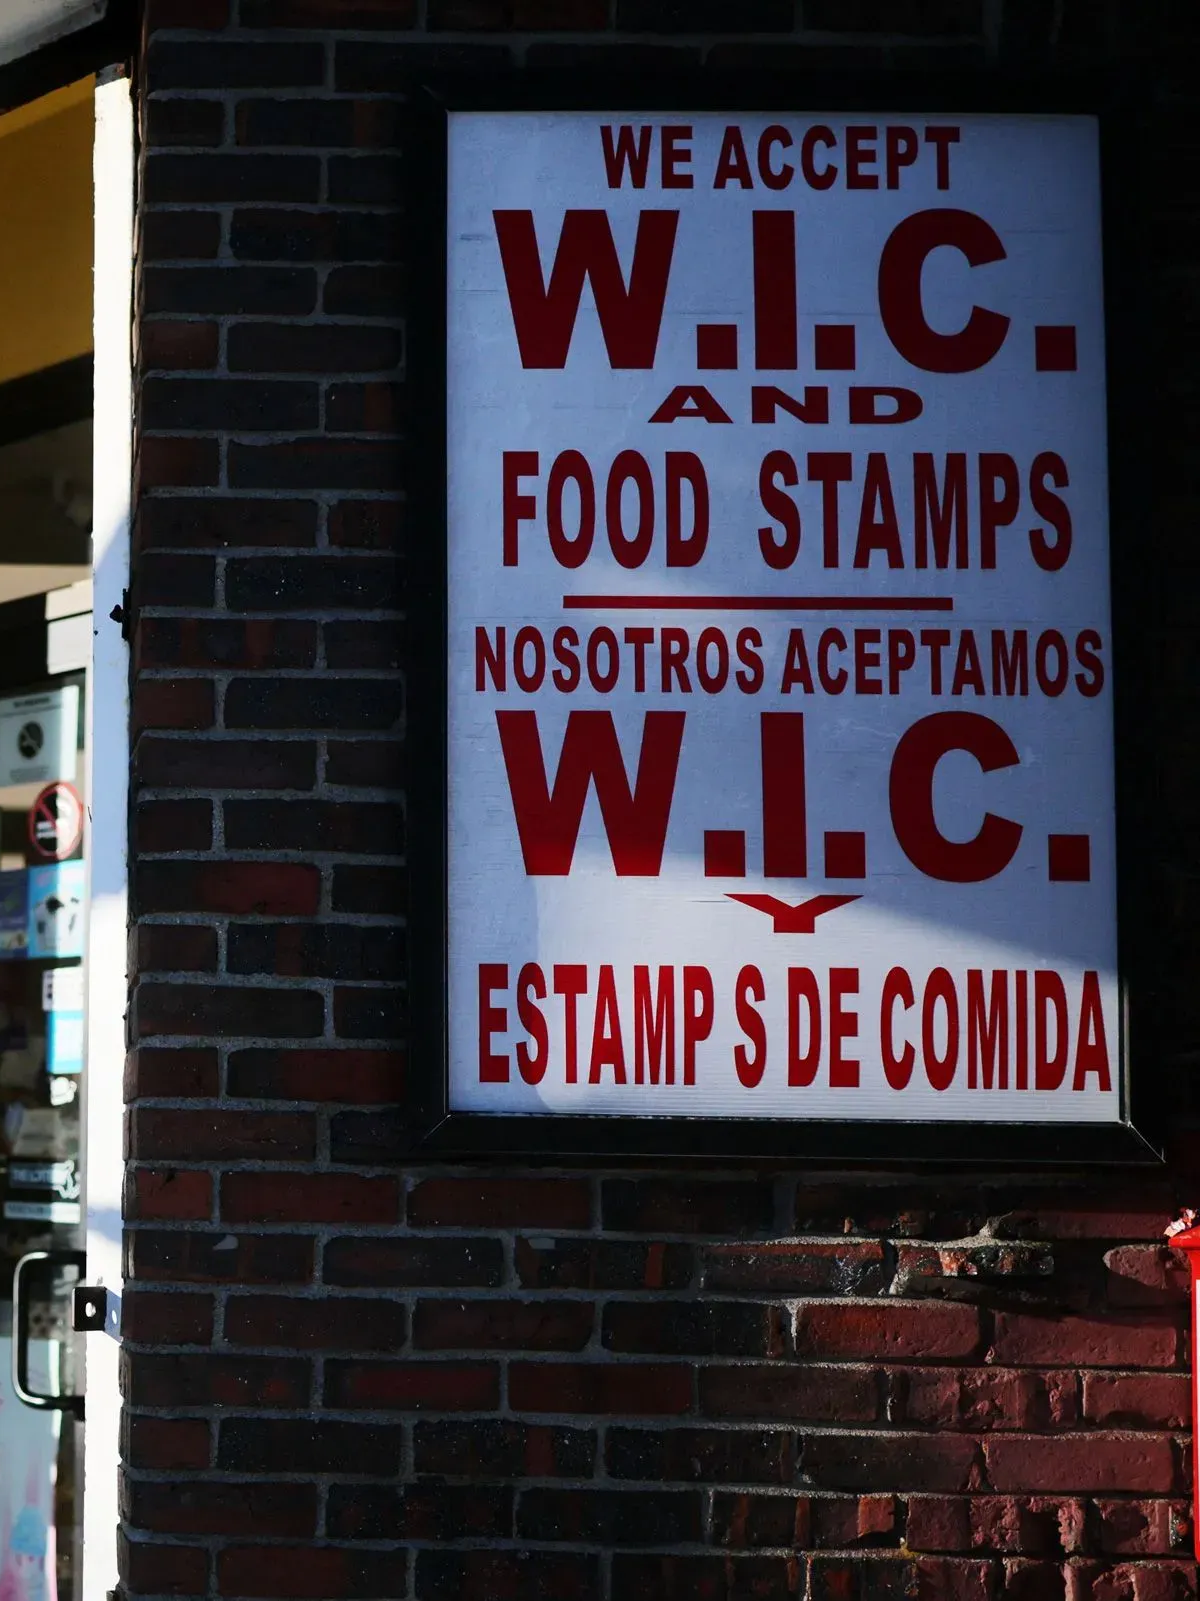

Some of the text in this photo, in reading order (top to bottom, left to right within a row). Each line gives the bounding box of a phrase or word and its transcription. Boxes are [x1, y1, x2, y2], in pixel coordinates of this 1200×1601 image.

[600, 125, 960, 191] WE ACCEPT
[492, 208, 1078, 374] W.I.C.
[647, 385, 923, 425] AND
[502, 449, 1073, 572] FOOD STAMPS
[475, 626, 1104, 697] NOSOTROS ACEPTAMOS
[494, 710, 1090, 883] W.I.C.
[723, 894, 864, 934] Y
[787, 967, 860, 1088] DE
[880, 967, 1112, 1092] COMIDA
